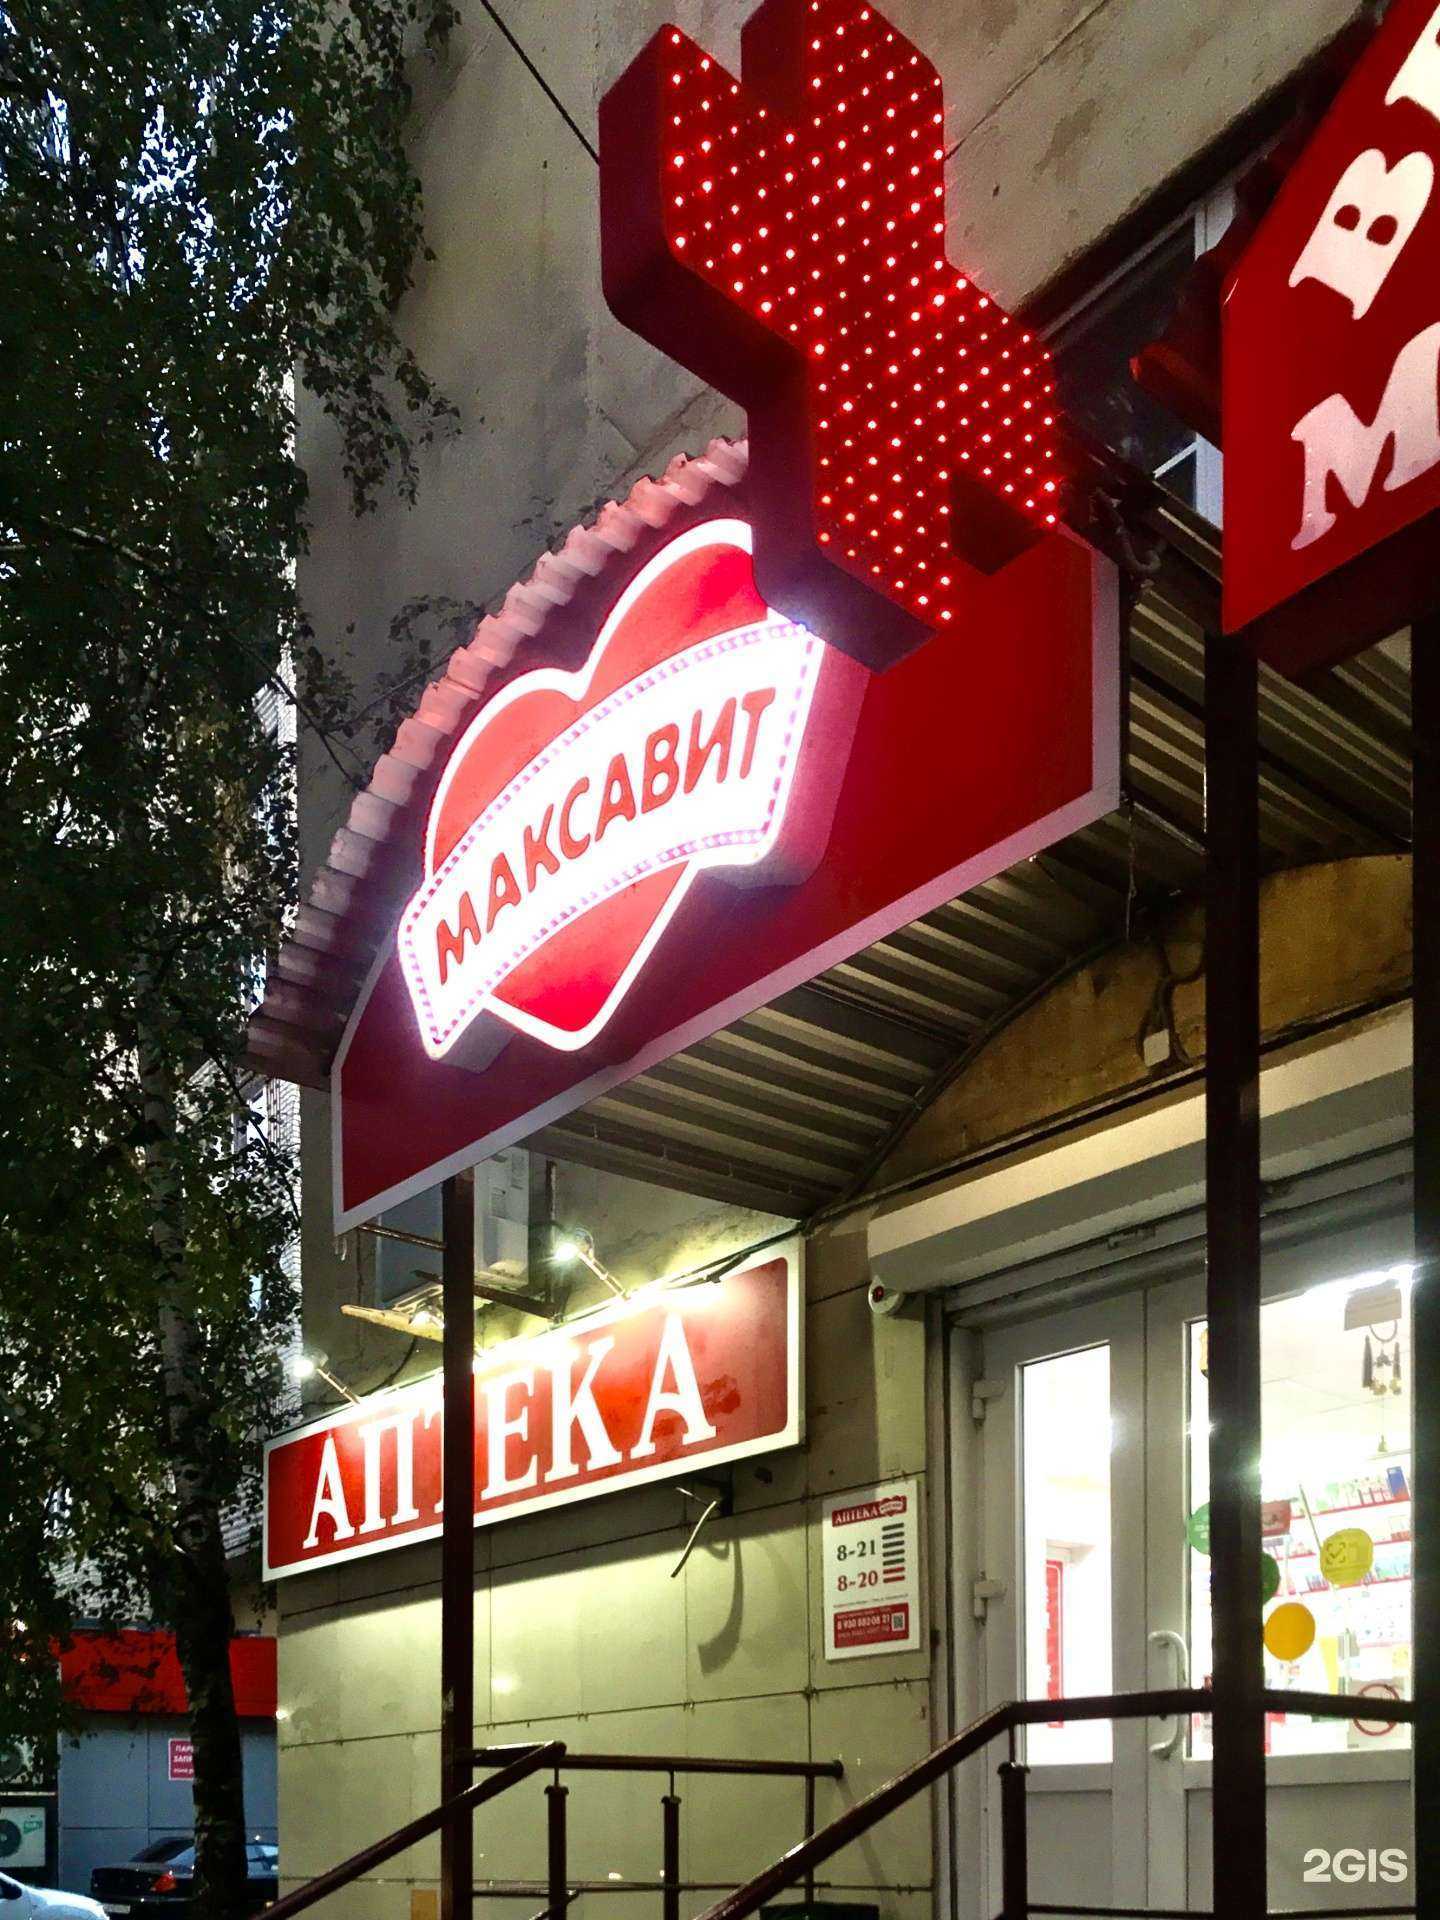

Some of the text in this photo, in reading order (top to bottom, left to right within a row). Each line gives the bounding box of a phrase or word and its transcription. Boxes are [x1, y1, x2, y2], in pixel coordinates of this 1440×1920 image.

[435, 686, 777, 986] МАКСАВИТ
[835, 1505, 878, 1524] АПТЕКА
[837, 1540, 876, 1561] 8-21
[837, 1570, 878, 1592] 8-20
